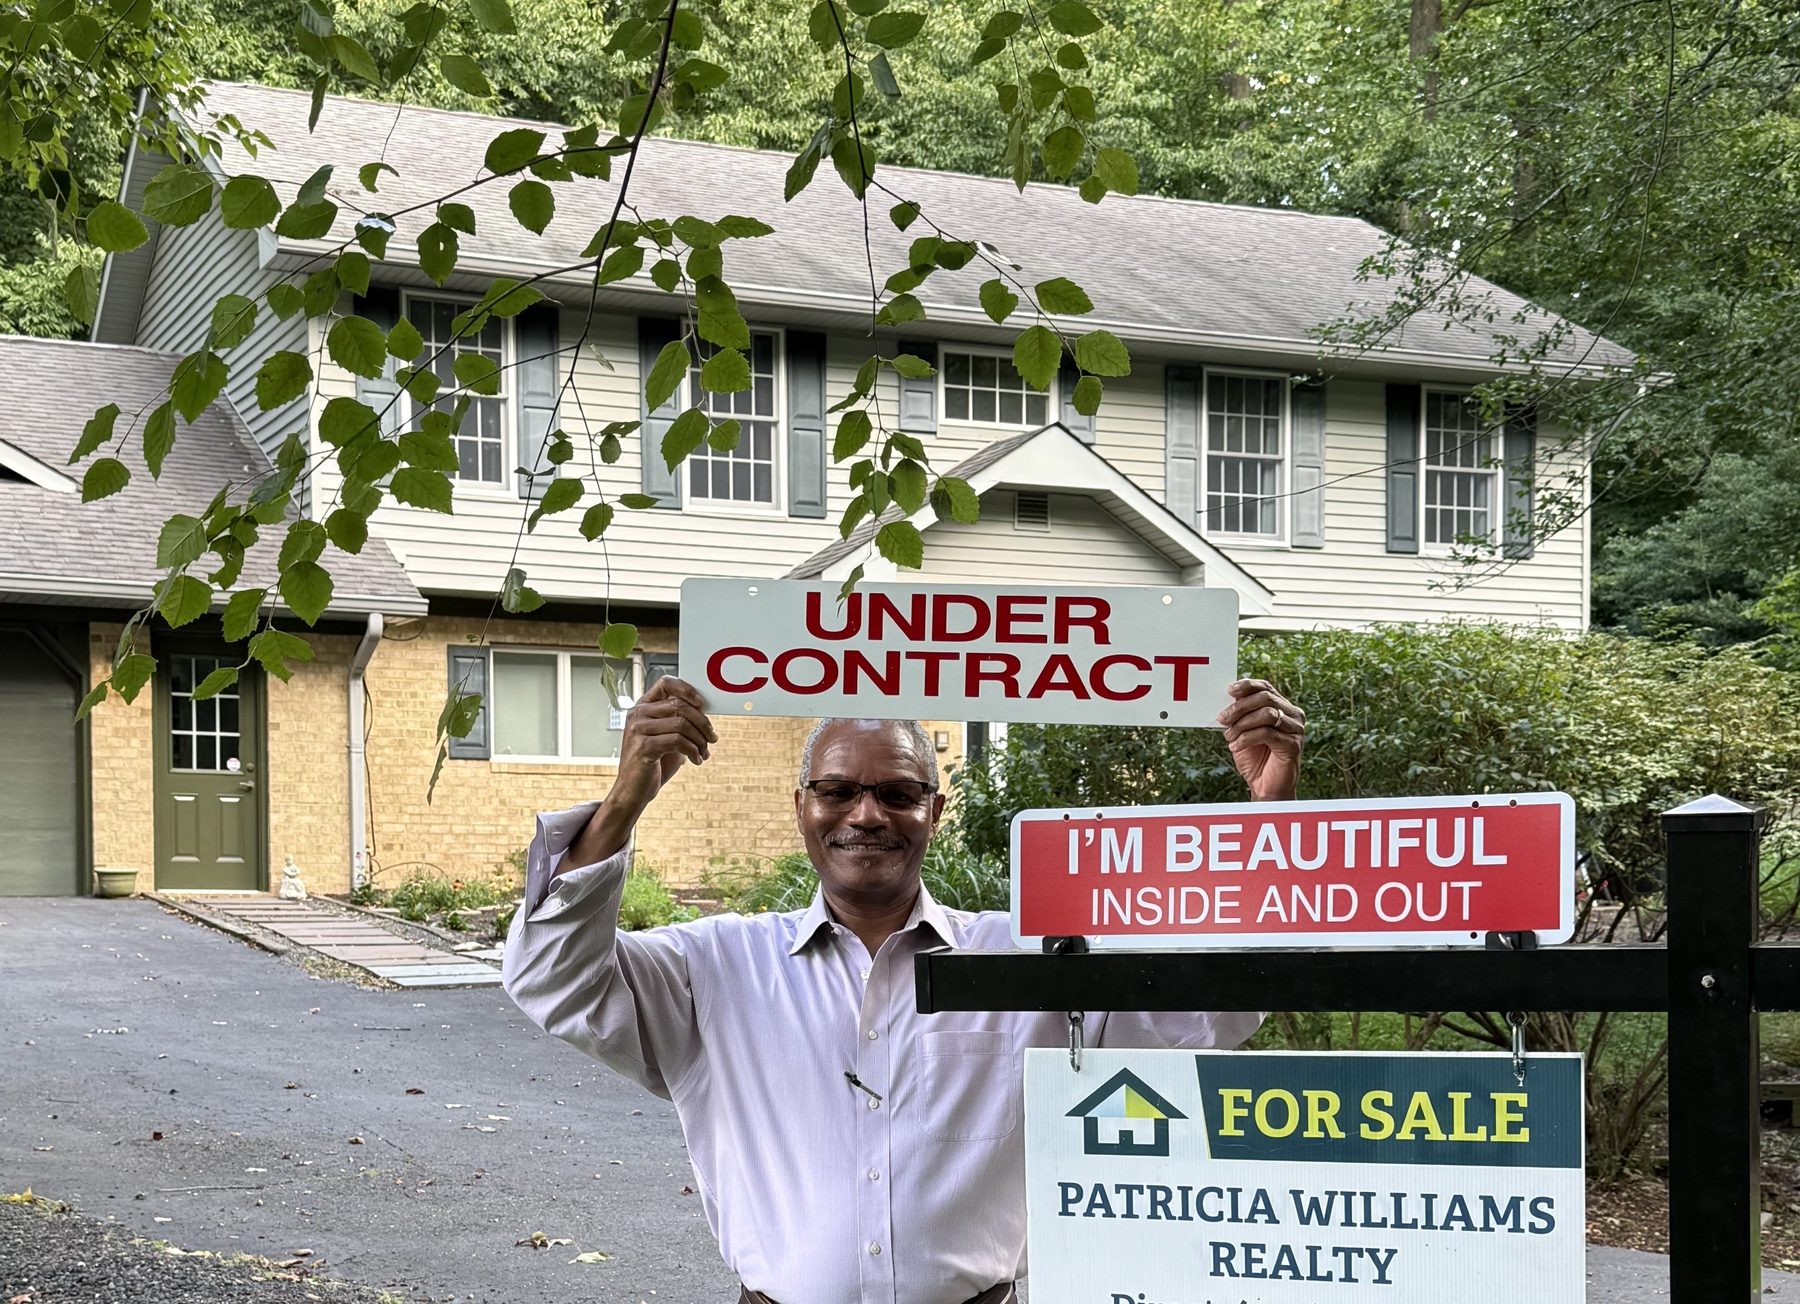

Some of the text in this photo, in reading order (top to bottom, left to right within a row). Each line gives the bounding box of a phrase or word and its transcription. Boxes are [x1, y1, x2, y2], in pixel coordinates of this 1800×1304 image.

[805, 591, 1111, 645] UNDER
[706, 646, 1209, 702] CONTRACT
[1165, 816, 1508, 873] BEAUTIFUL
[1092, 881, 1483, 926] INSIDE AND OUT
[1217, 1087, 1531, 1143] FOR SALE
[1057, 1181, 1556, 1235] PATRICIA WILLIAMS
[1208, 1241, 1398, 1285] REALTY
